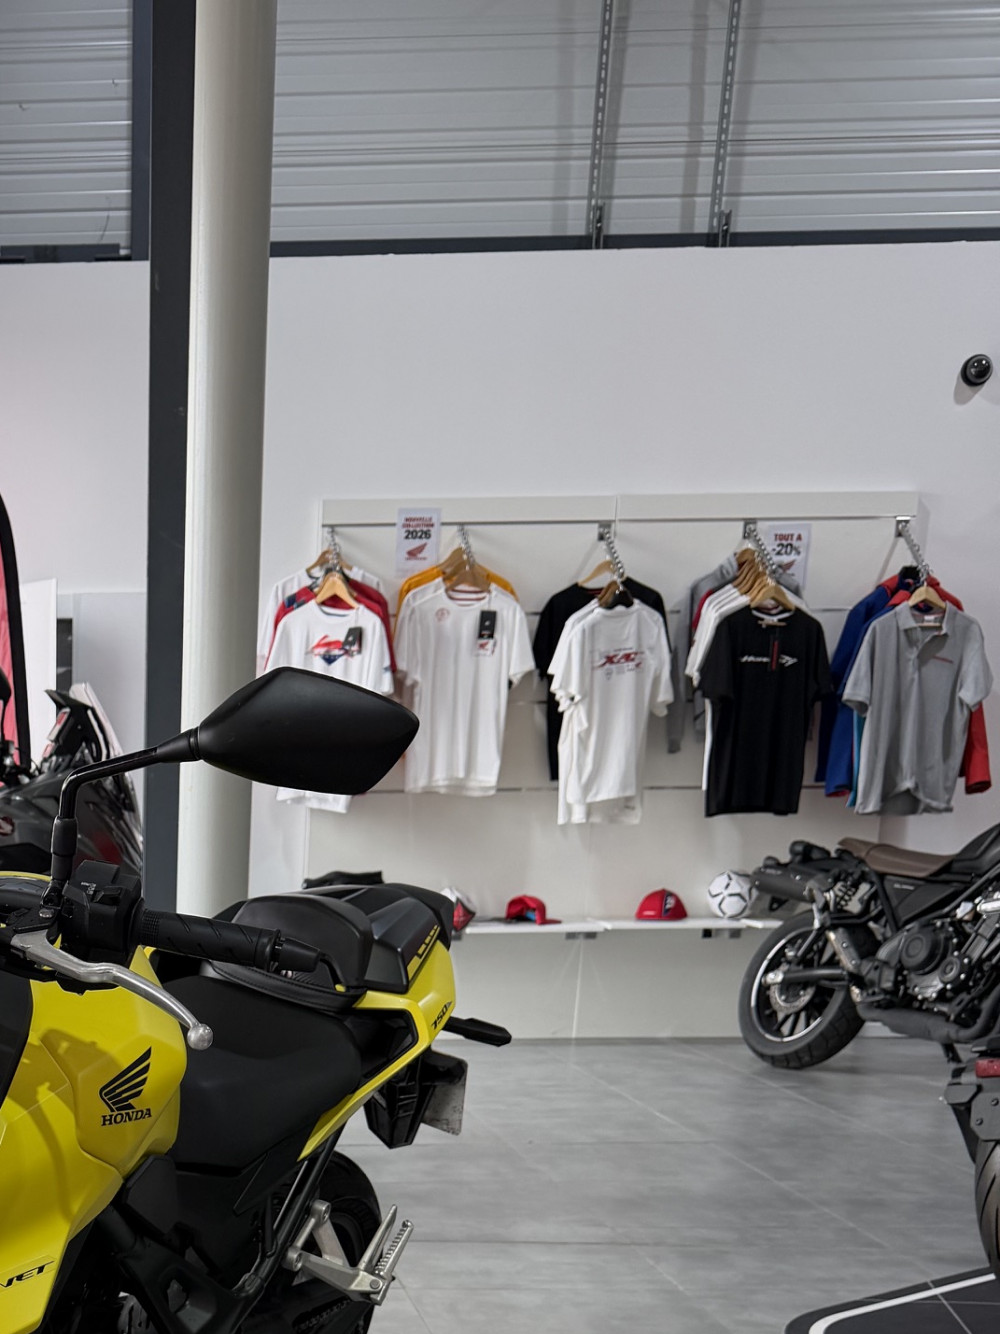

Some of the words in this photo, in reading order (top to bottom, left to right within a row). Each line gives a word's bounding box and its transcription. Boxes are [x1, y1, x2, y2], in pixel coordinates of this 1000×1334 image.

[404, 529, 432, 540] 2026
[774, 533, 795, 542] TOUT
[772, 543, 802, 556] -20%
[431, 1003, 450, 1030] 750
[101, 1108, 152, 1126] HONDA
